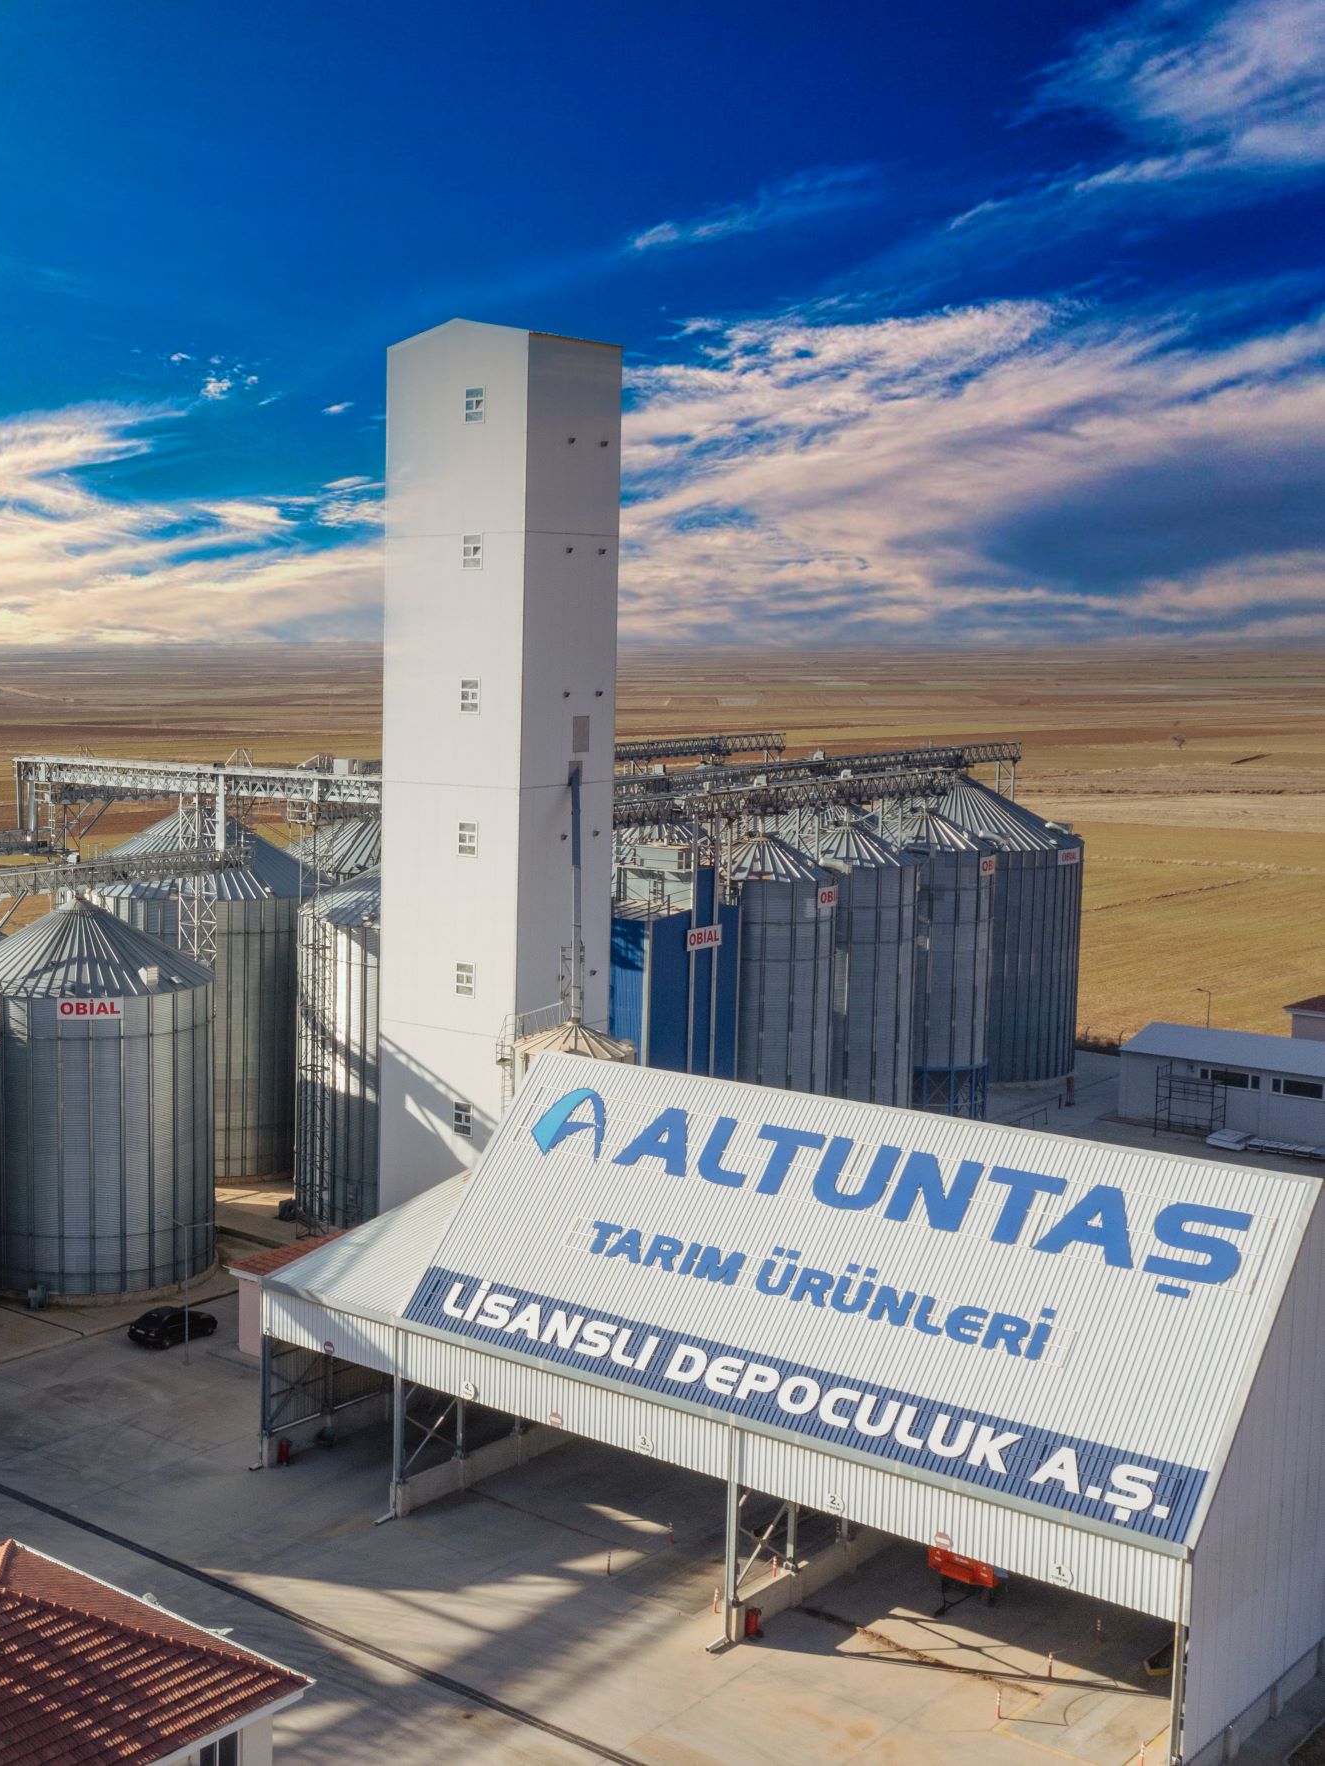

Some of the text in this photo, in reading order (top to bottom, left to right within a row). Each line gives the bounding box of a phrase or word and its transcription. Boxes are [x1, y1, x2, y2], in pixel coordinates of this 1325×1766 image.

[60, 999, 121, 1016] OBİAL
[612, 1107, 1253, 1299] ALTUNTAŞ
[589, 1220, 1057, 1361] TARIM ÜRÜNLERİ
[442, 1280, 1170, 1522] LİSANSLI DEPOCULUK A.Ş.
